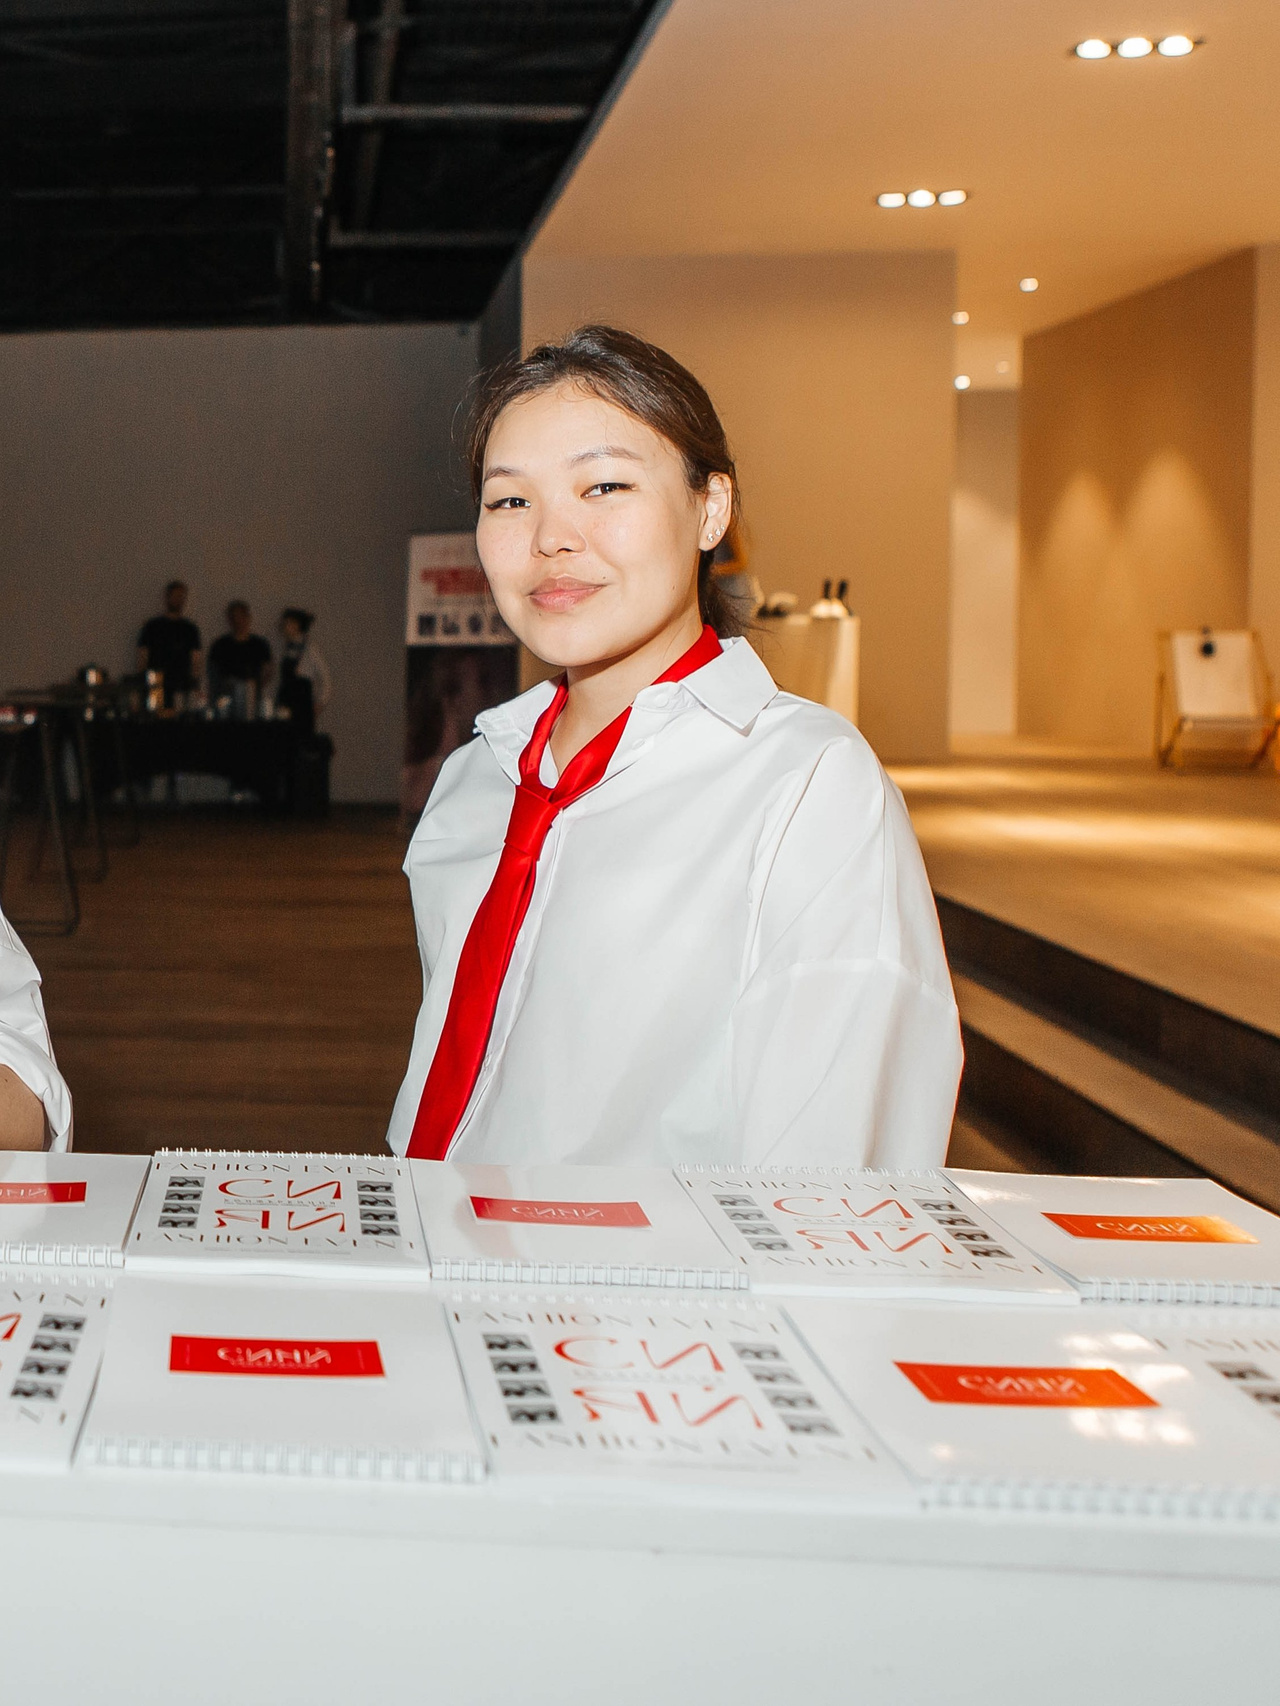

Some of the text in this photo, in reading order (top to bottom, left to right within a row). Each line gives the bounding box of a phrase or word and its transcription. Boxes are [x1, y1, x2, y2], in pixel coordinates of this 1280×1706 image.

[155, 1162, 291, 1174] FASHION
[217, 1178, 342, 1200] СИ
[685, 1179, 833, 1190] FASHION
[773, 1196, 914, 1219] СИ
[136, 1232, 288, 1244] FASHION
[738, 1256, 908, 1269] FASHION
[553, 1335, 726, 1372] СИ
